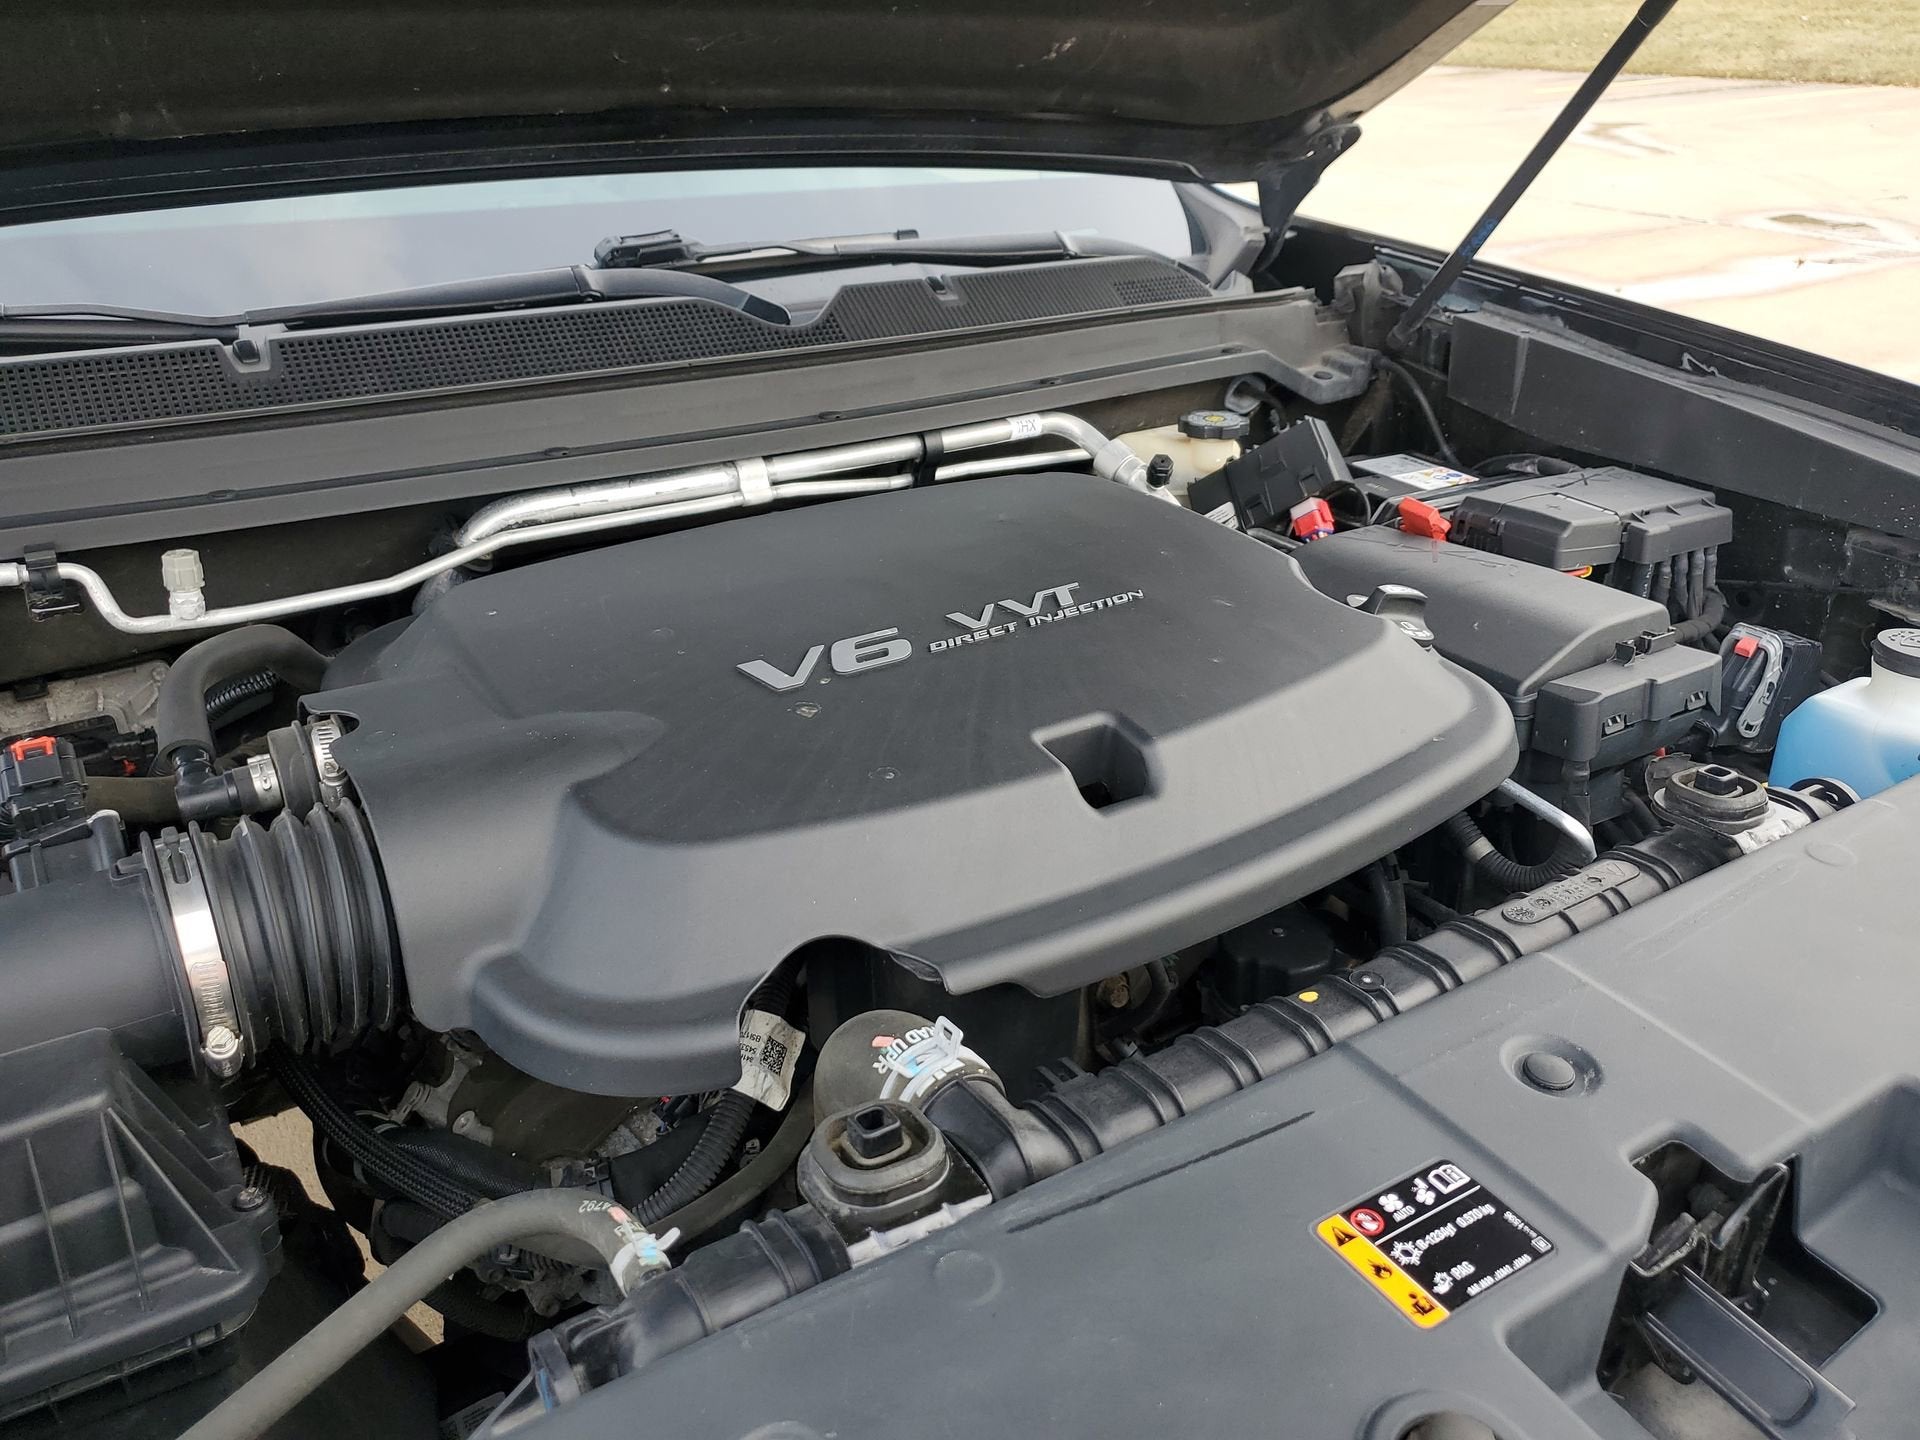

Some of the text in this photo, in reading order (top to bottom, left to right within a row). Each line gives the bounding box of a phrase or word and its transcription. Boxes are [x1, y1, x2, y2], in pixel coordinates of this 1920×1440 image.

[928, 589, 1144, 653] DIRECT INJECTION
[945, 582, 1080, 630] VVT
[736, 627, 914, 692] V6
[1393, 1205, 1416, 1222] AUTO
[1415, 1203, 1496, 1251] R-1234yf 0.570 kg
[1450, 1261, 1476, 1281] PAG
